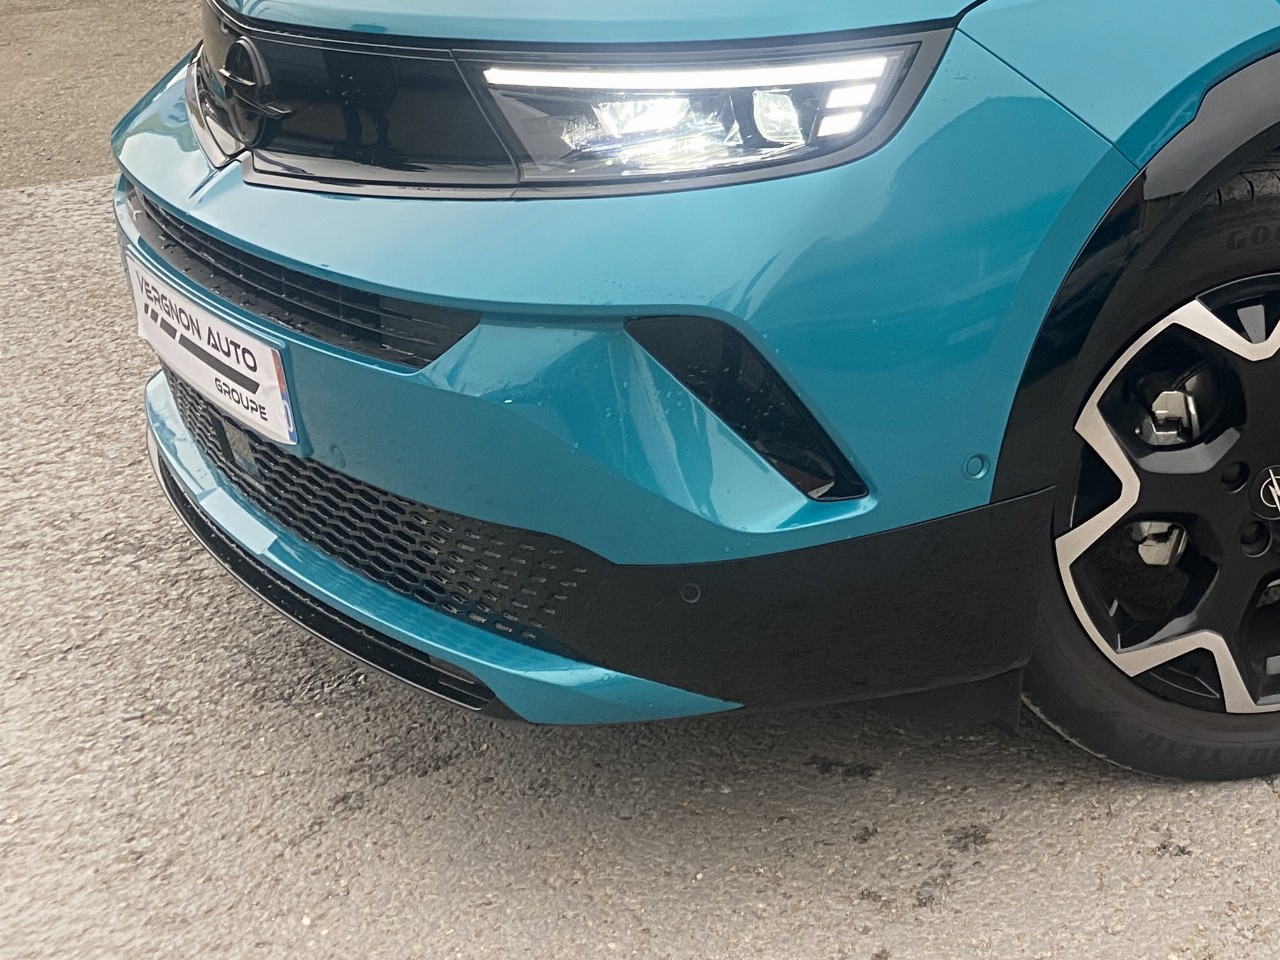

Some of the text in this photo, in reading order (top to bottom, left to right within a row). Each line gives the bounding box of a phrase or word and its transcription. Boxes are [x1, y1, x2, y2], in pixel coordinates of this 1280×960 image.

[135, 270, 258, 373] VERGNON AUTO
[214, 377, 269, 422] GROUPE
